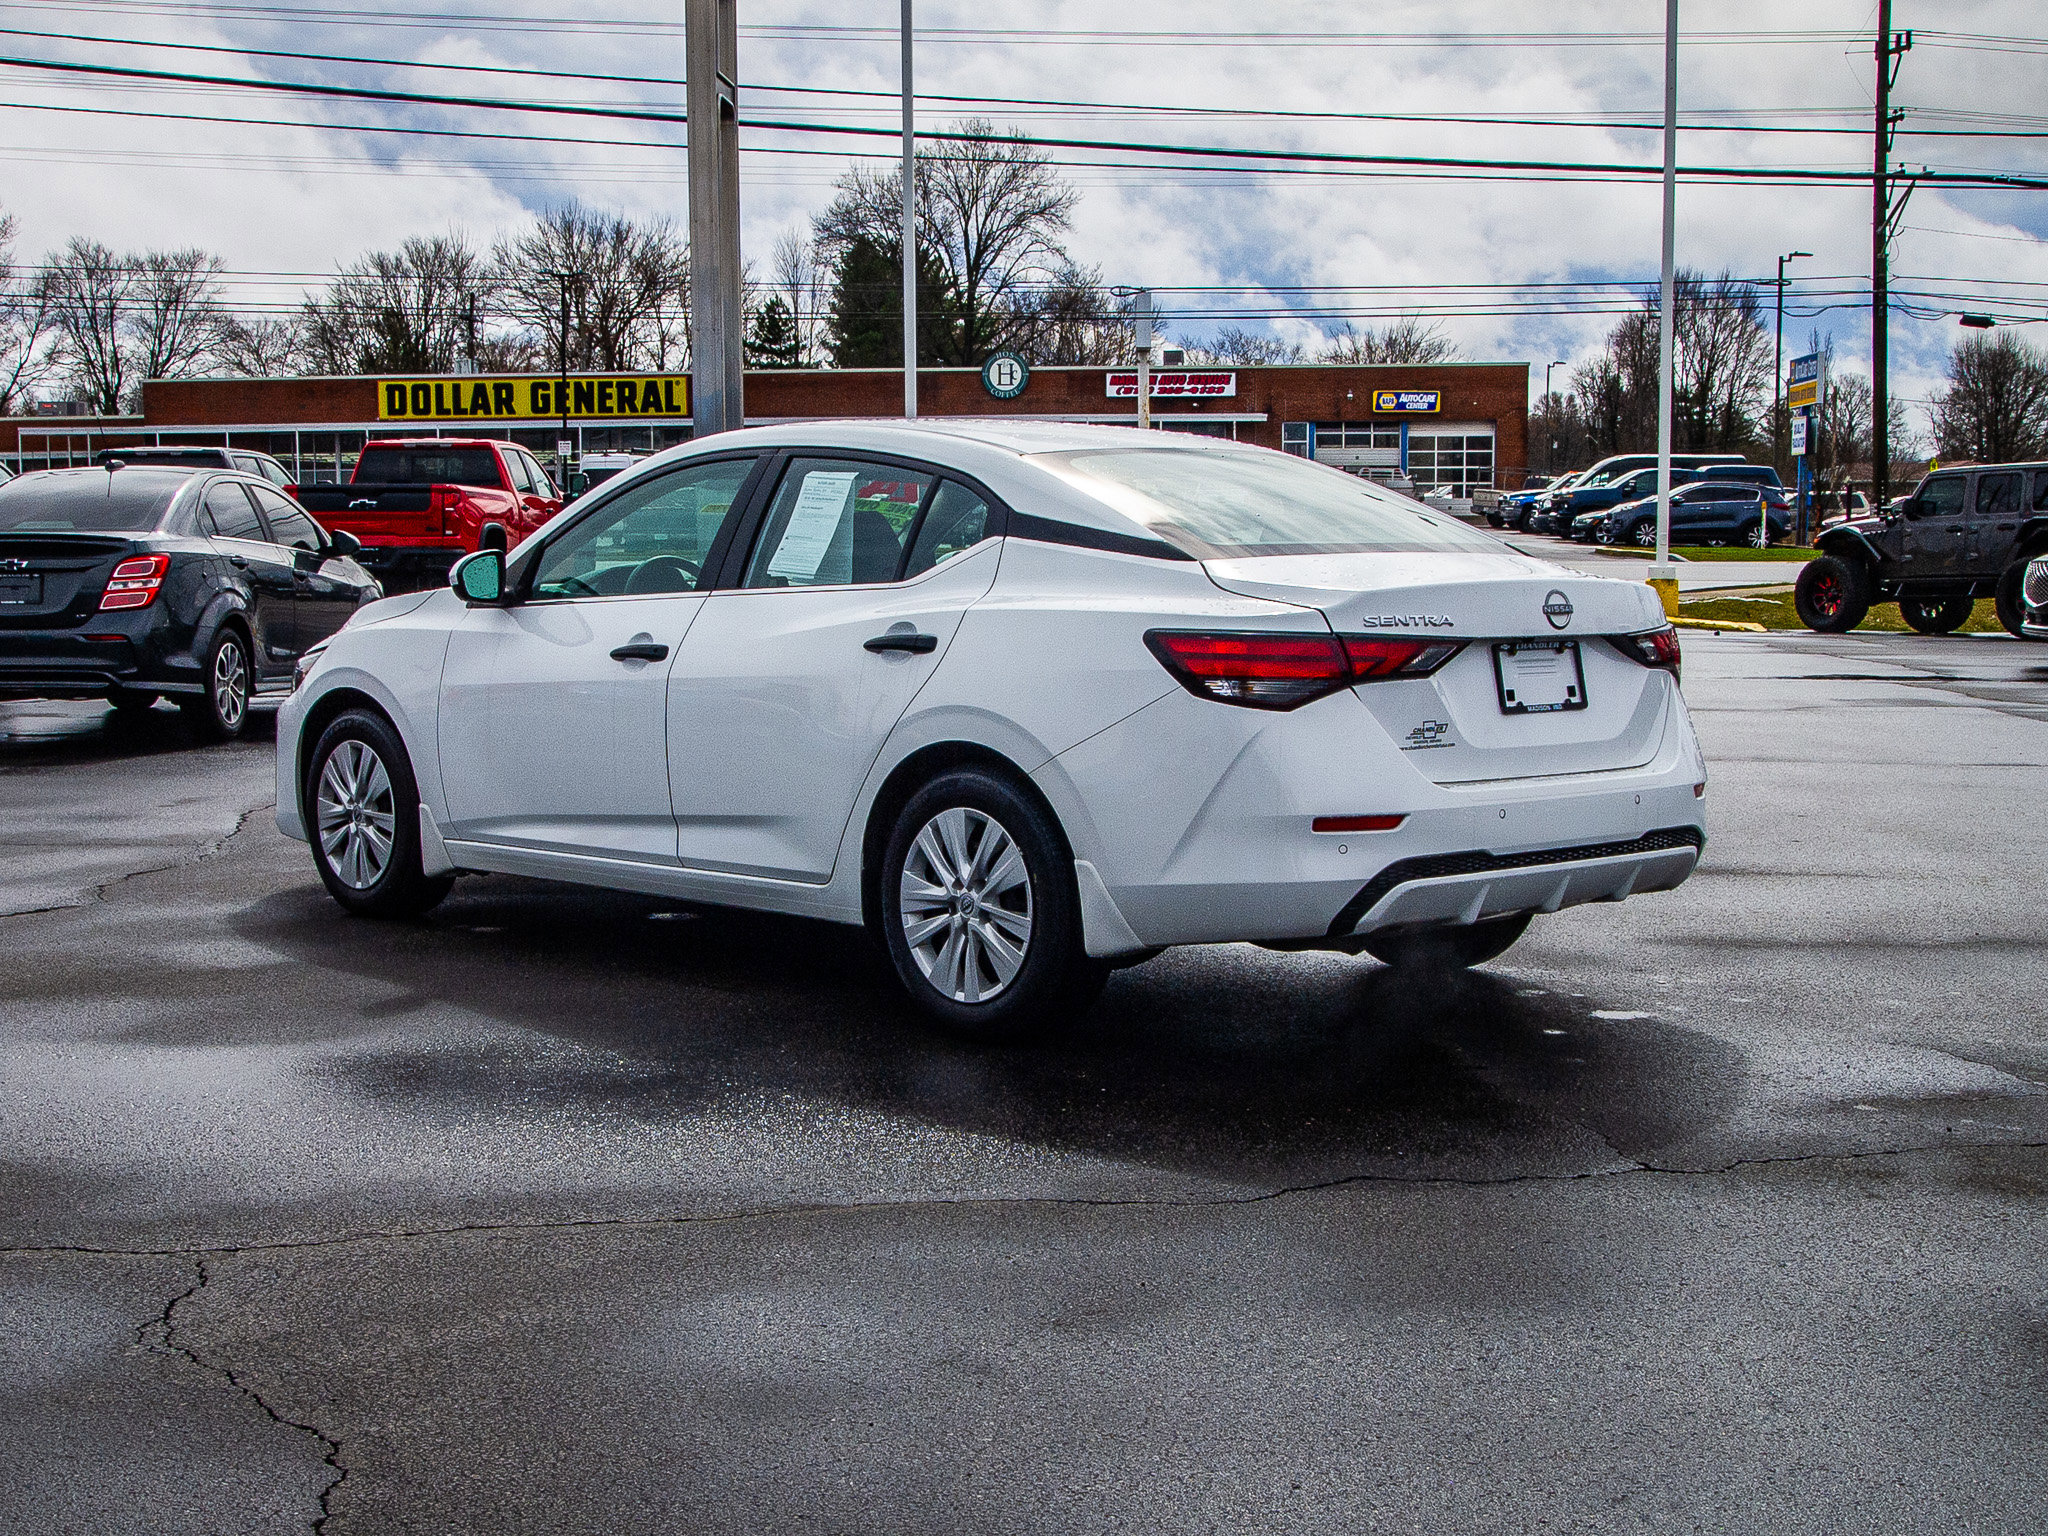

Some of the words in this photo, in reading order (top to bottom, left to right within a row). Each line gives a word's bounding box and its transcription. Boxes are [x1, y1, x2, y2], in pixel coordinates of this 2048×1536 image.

[1110, 375, 1158, 386] MADIN
[1158, 375, 1187, 385] AUTO
[1187, 374, 1232, 385] SERVICE
[990, 388, 1020, 398] COFFEE
[386, 382, 516, 416] DOLLAR
[530, 380, 681, 415] GENERAL
[1382, 397, 1395, 405] NAPA
[1544, 604, 1573, 613] NISSAN
[1363, 614, 1454, 627] SENTRA
[1516, 642, 1560, 650] CHANDLER
[1412, 725, 1446, 733] CHANDLER
